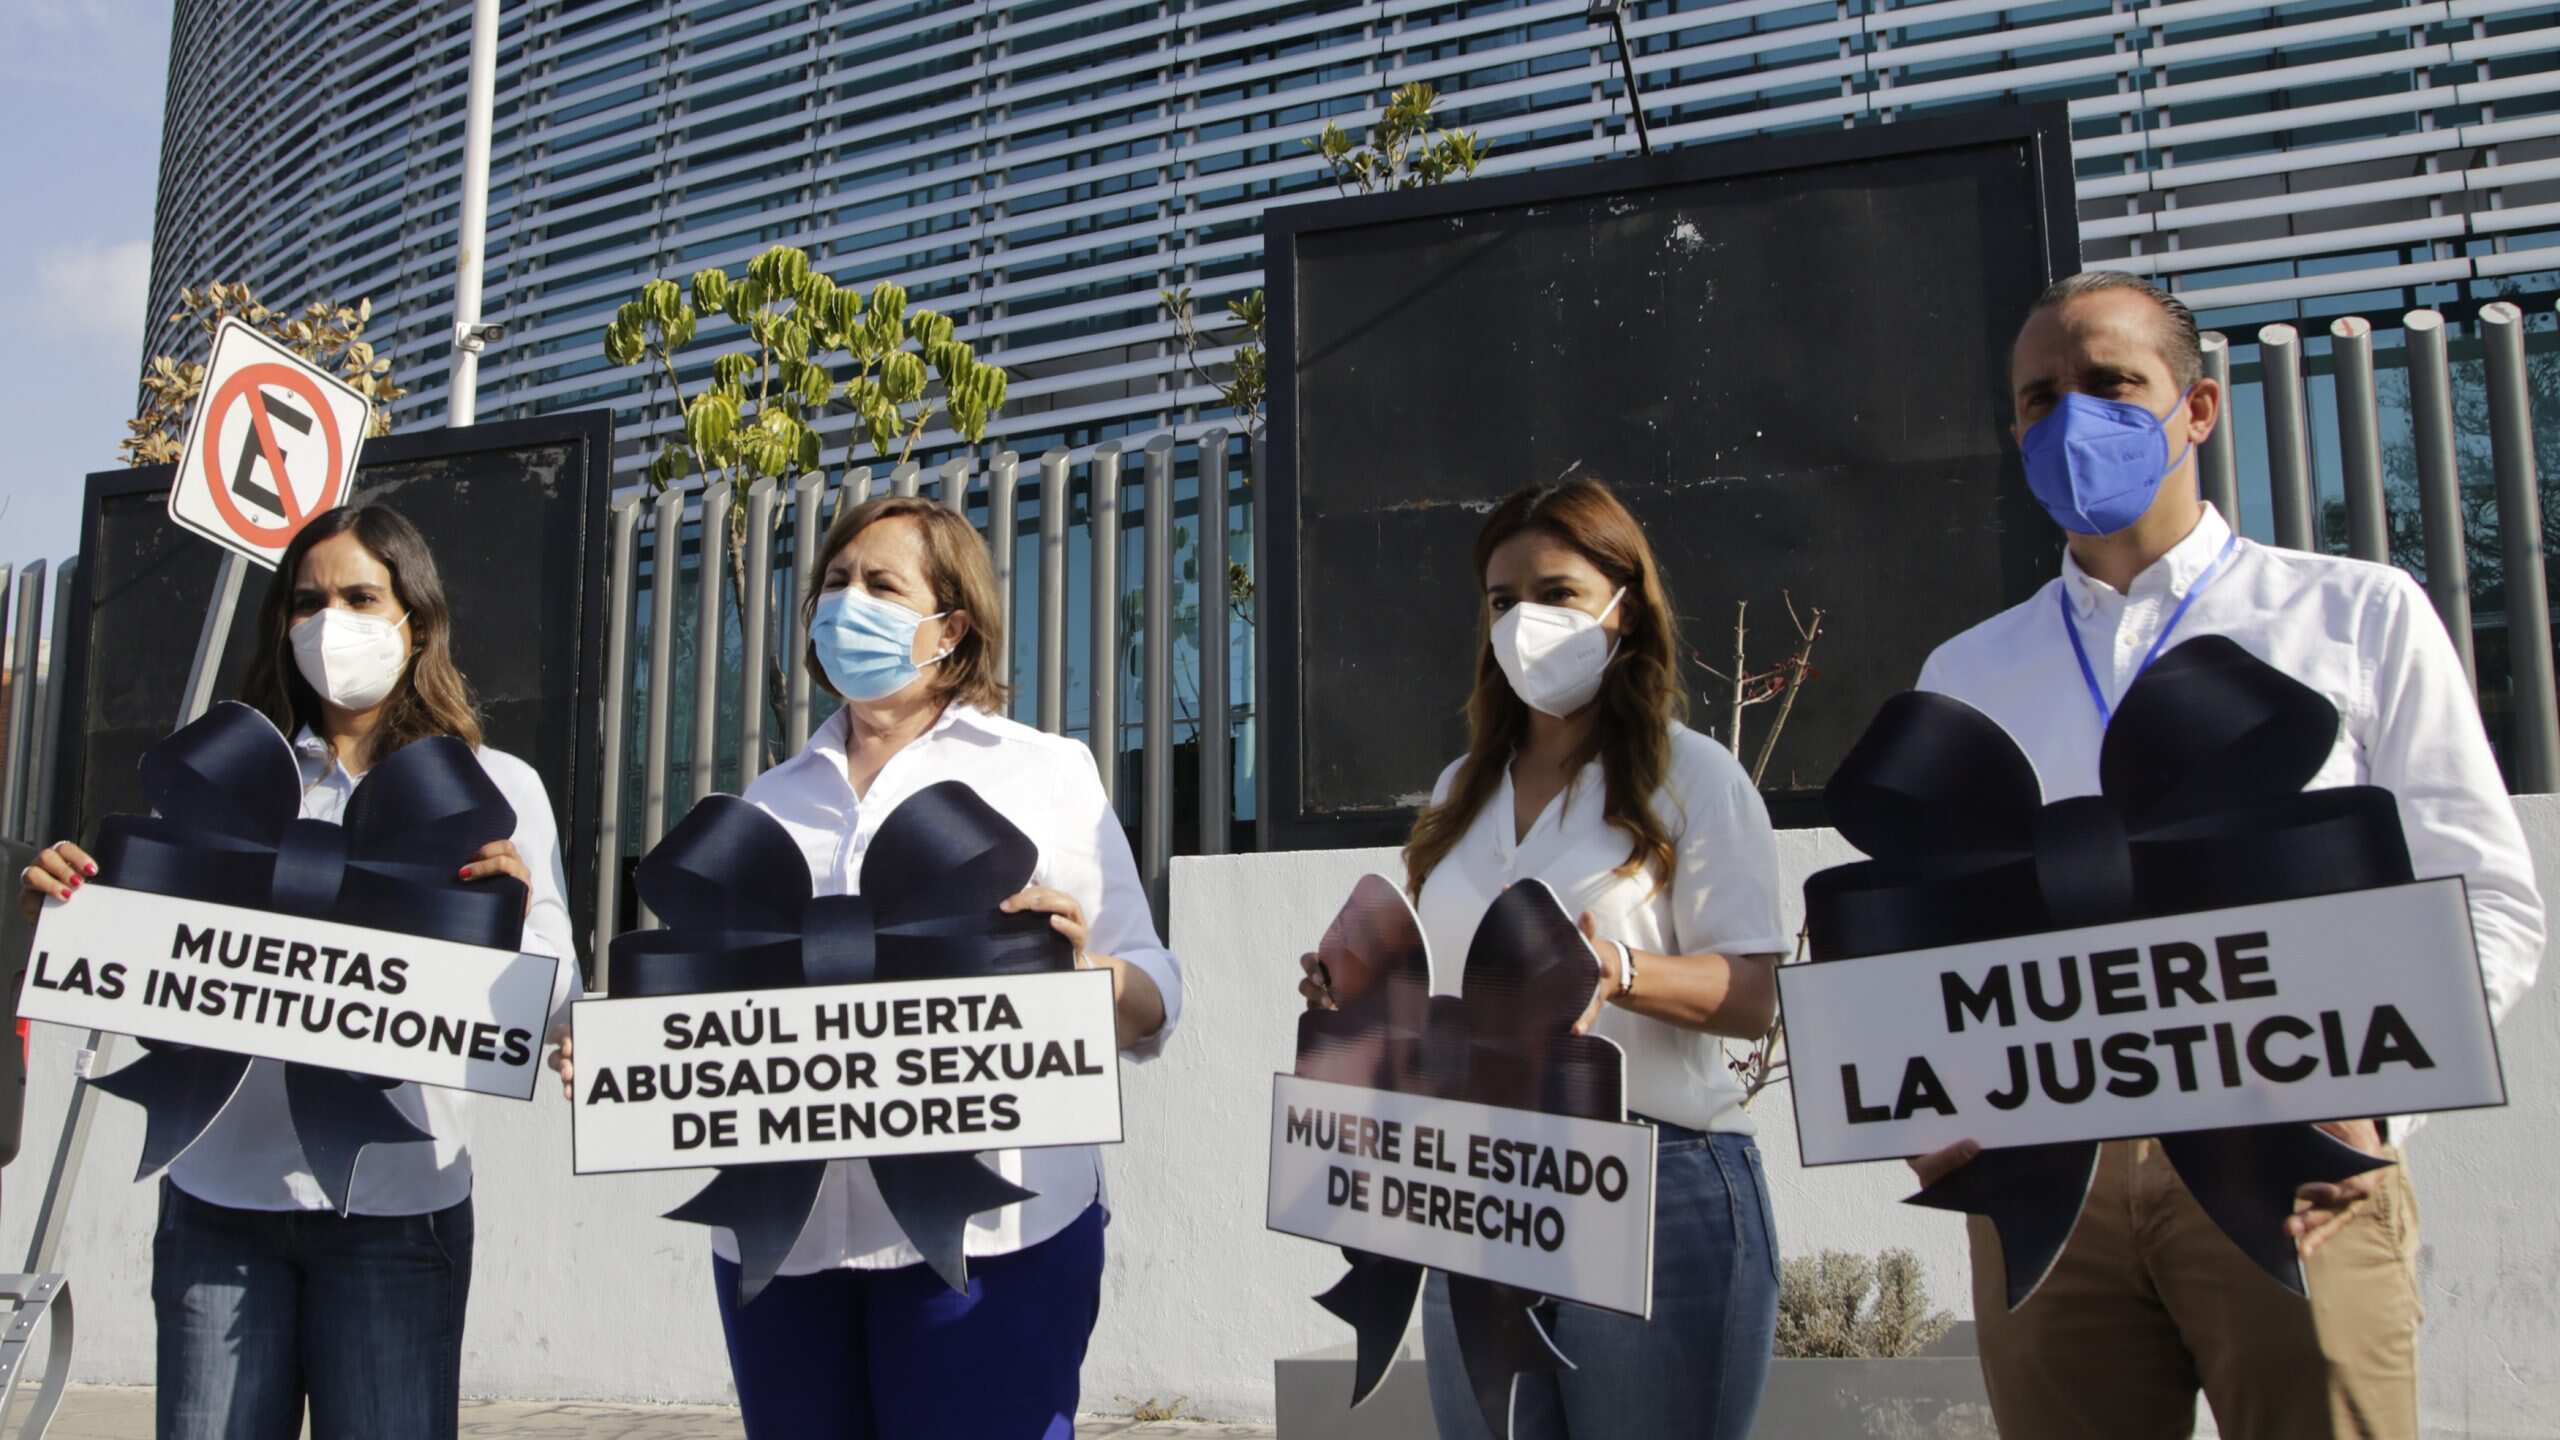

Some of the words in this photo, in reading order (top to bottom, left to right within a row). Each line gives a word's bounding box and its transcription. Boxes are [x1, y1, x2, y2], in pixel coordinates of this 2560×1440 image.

[171, 923, 409, 995] MUERTAS
[1939, 930, 2279, 1034] MUERE
[32, 951, 127, 1000] LAS
[143, 969, 533, 1067] INSTITUCIONES
[663, 998, 798, 1050] SAÚL
[815, 994, 1022, 1041] HUERTA
[586, 1052, 878, 1105] ABUSADOR
[896, 1039, 1103, 1086] SEXUAL
[1839, 1055, 1959, 1126] LA
[1984, 1003, 2437, 1112] JUSTICIA
[673, 1110, 738, 1150] DE
[759, 1093, 1021, 1145] MENORES
[1286, 1105, 1402, 1164] MUERE
[1413, 1126, 1457, 1174] EL
[1467, 1134, 1629, 1203] ESTADO
[1327, 1164, 1370, 1213] DE
[1381, 1175, 1566, 1253] DERECHO
